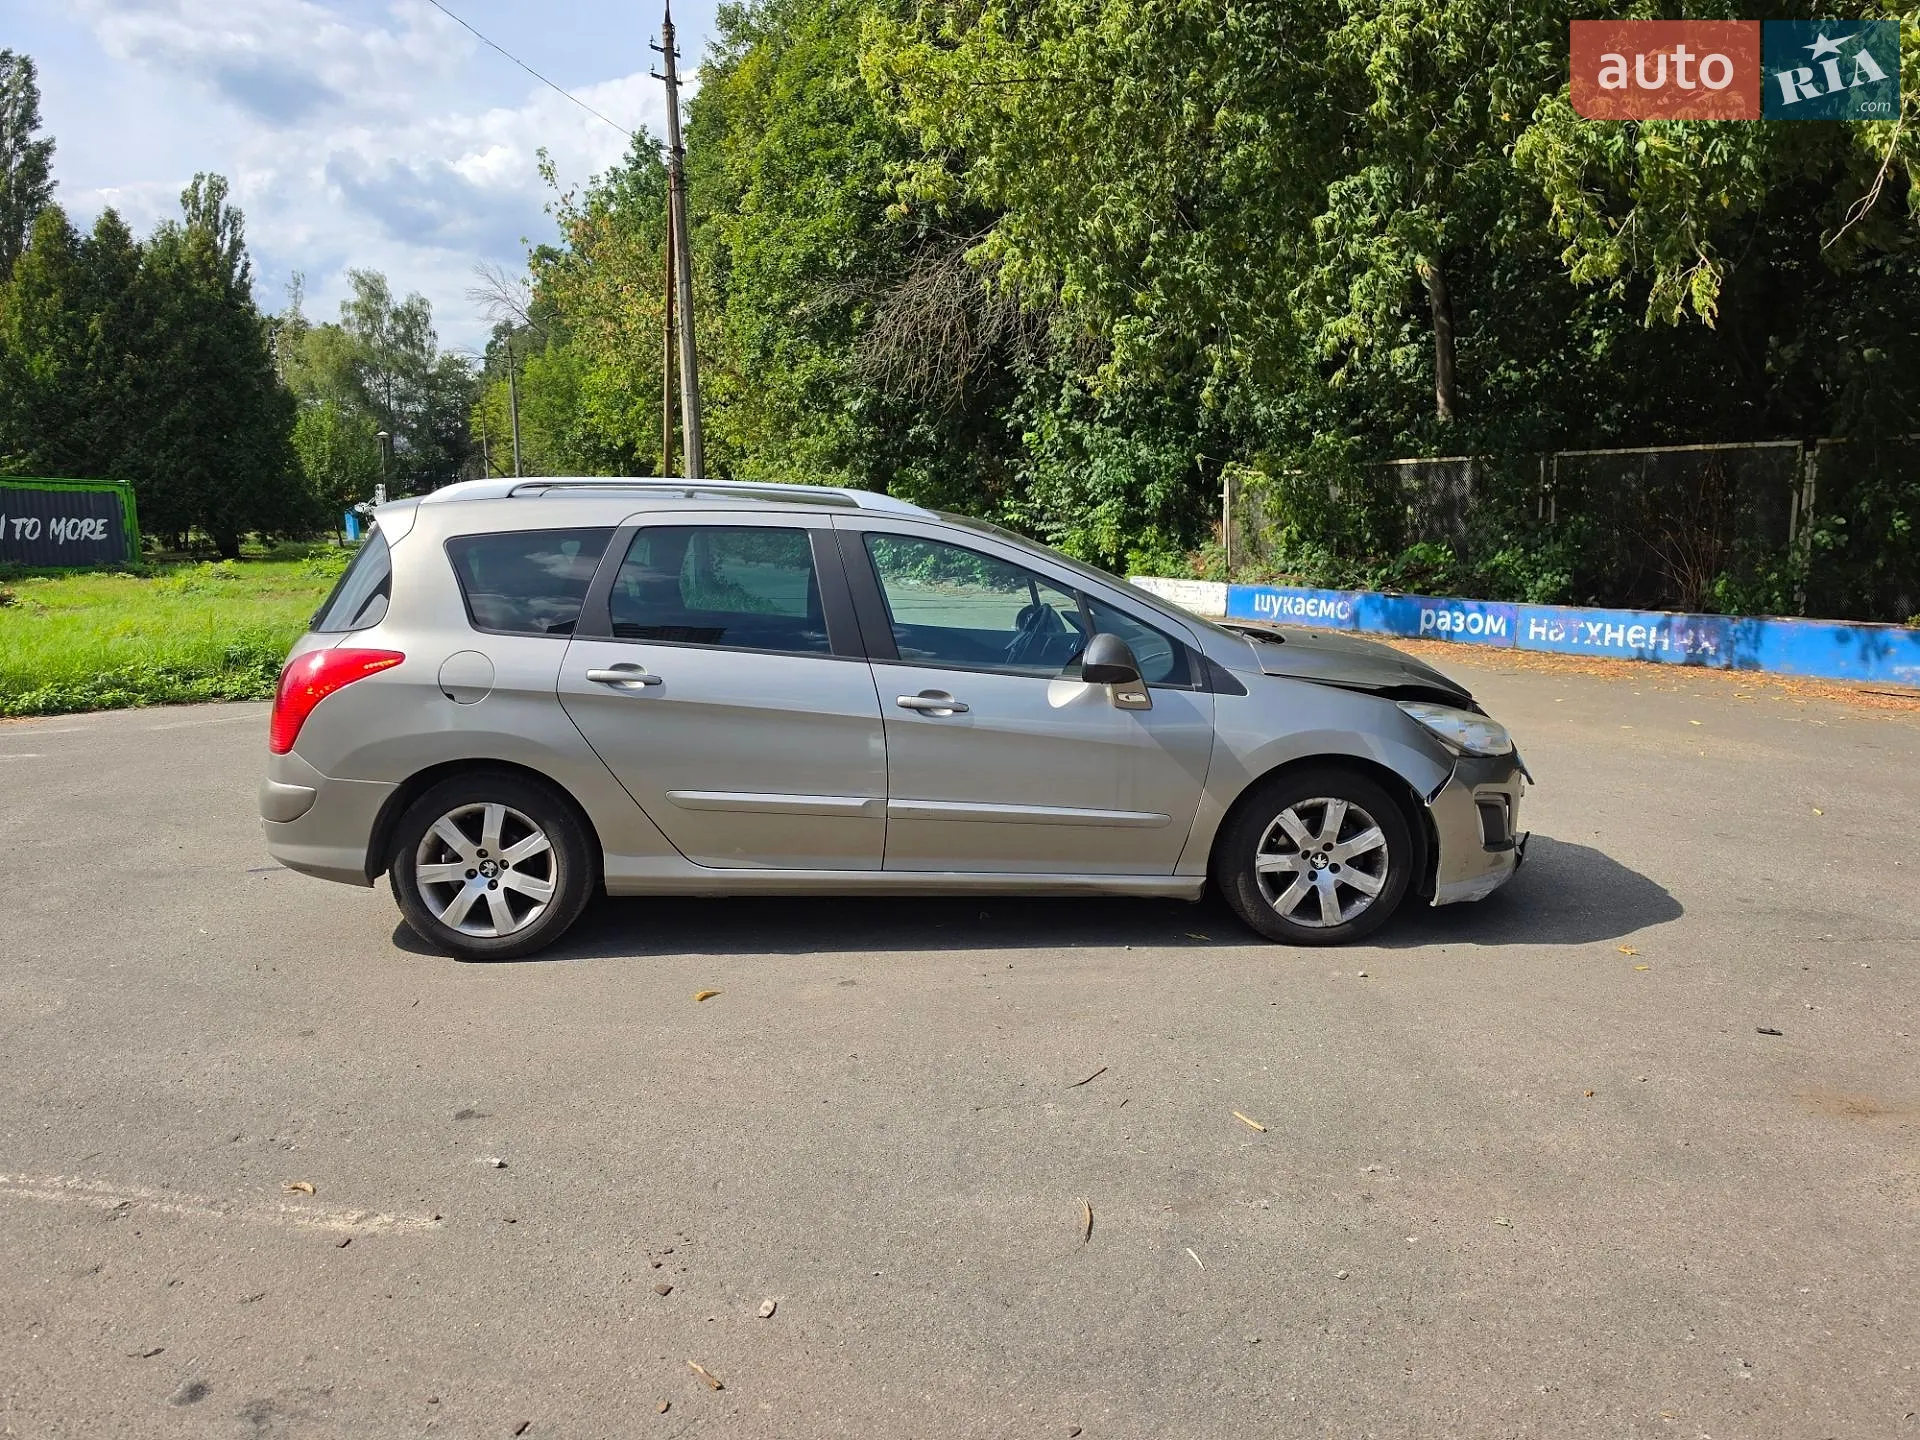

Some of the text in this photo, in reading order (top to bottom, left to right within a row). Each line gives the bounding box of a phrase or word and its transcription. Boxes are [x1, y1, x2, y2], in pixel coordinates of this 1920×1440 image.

[9, 517, 42, 541] TO
[49, 516, 109, 545] MORE
[1254, 593, 1351, 620] шукаємо
[1420, 607, 1507, 637] разом
